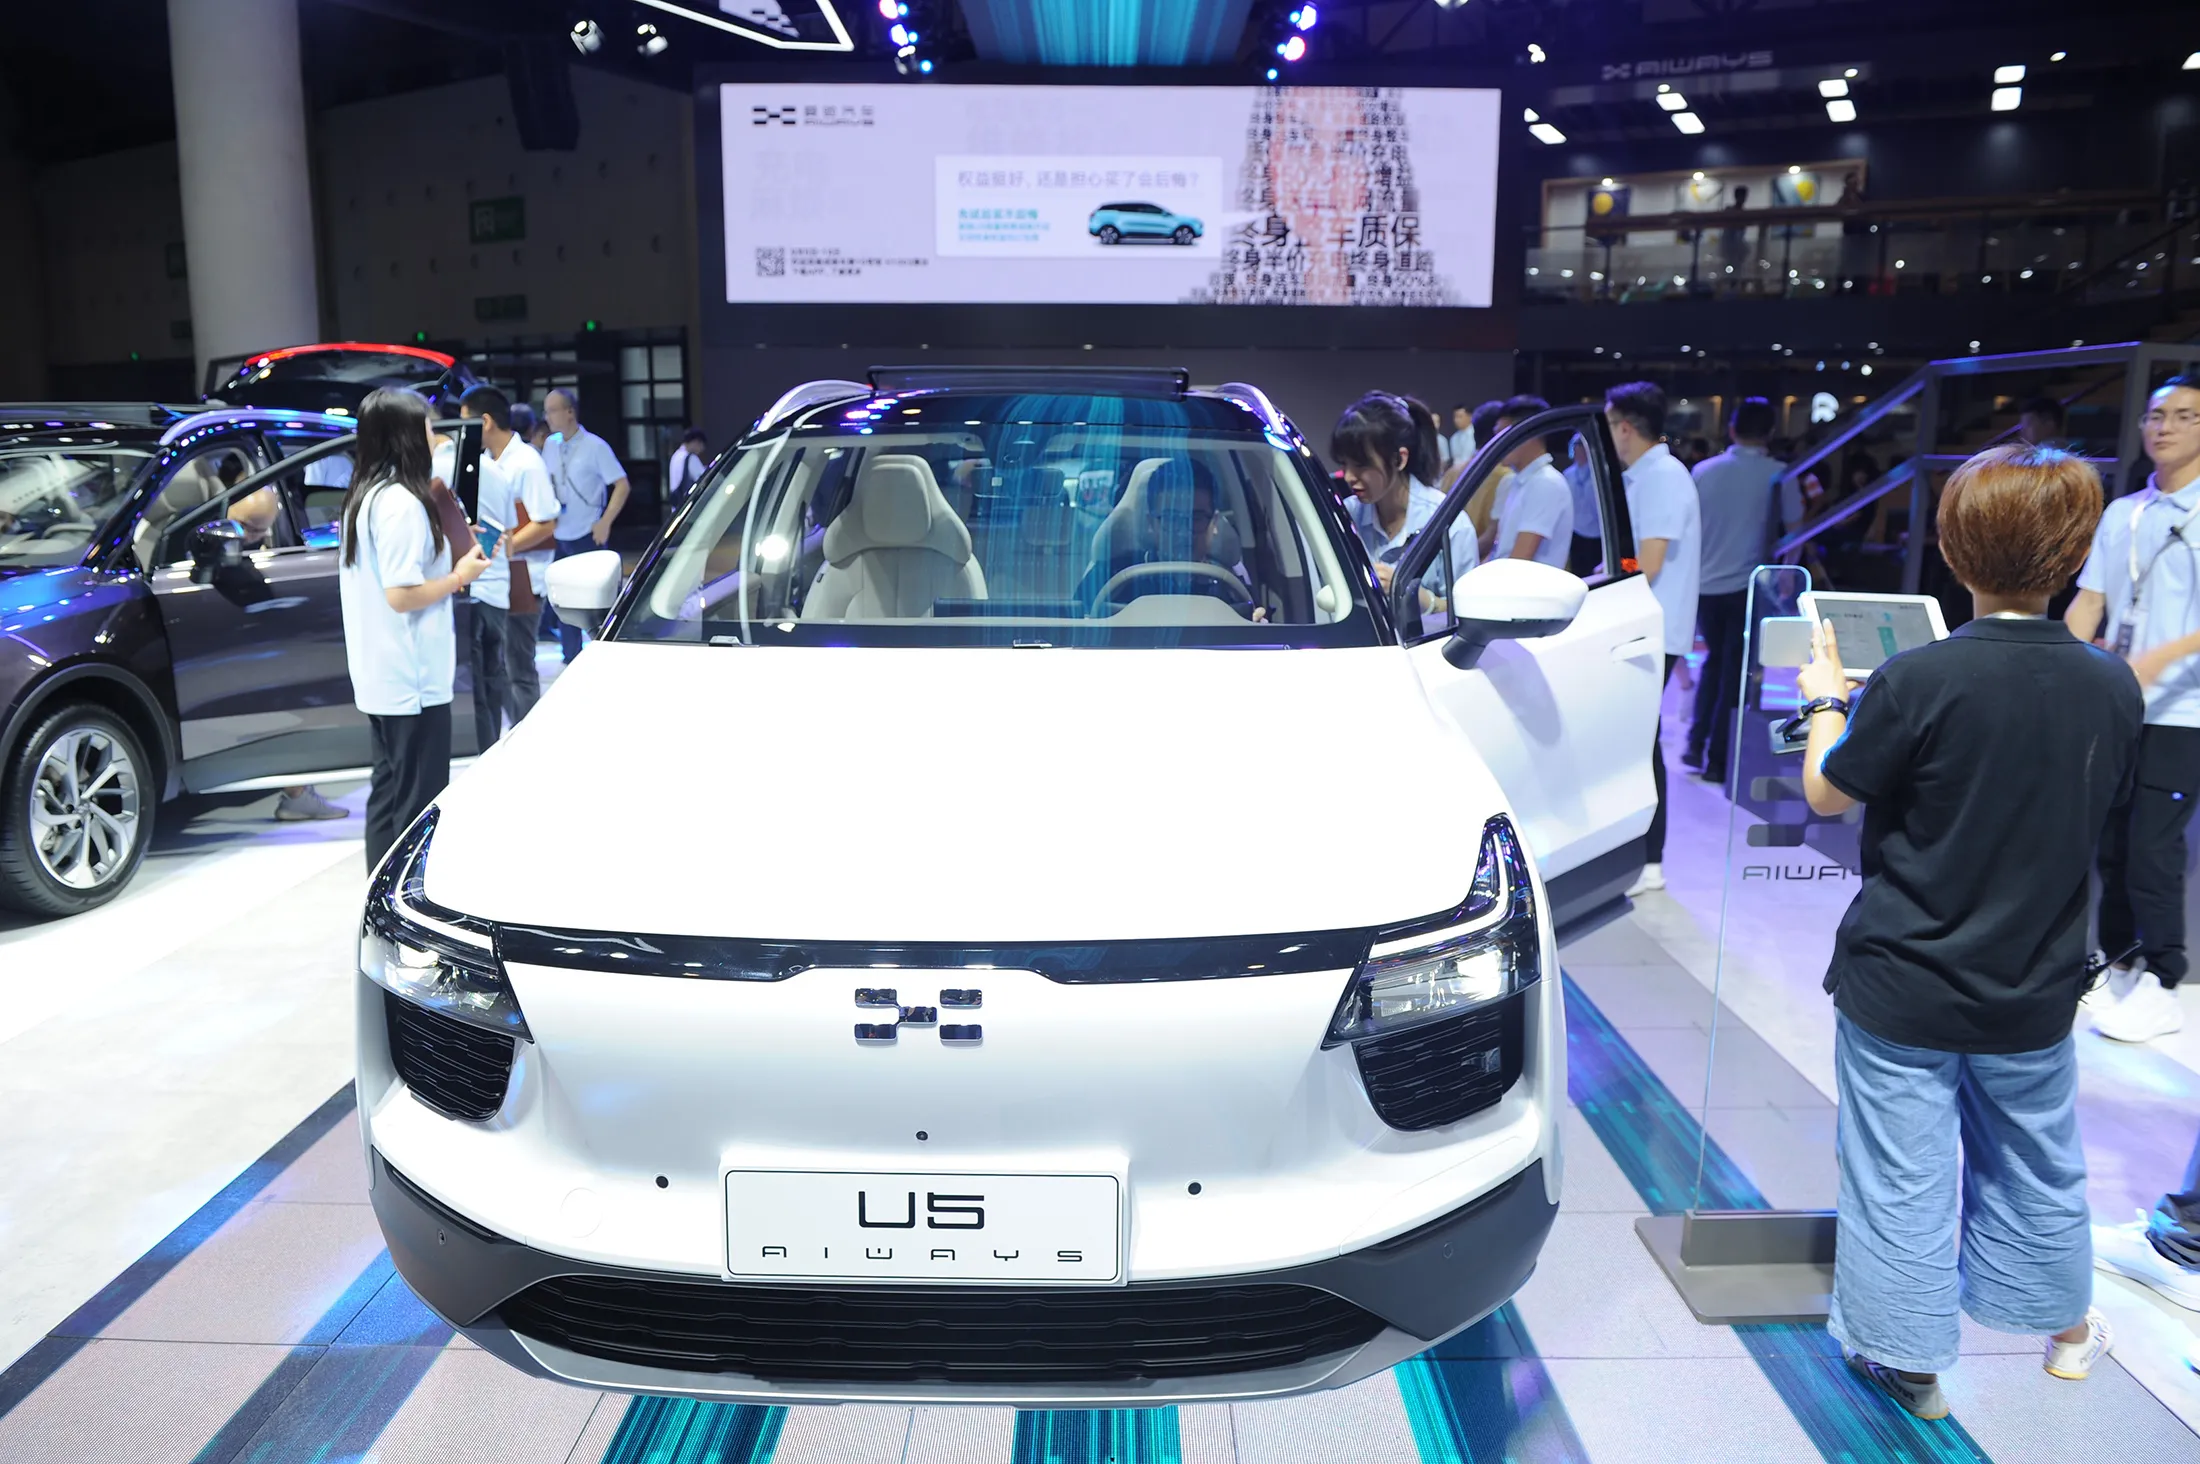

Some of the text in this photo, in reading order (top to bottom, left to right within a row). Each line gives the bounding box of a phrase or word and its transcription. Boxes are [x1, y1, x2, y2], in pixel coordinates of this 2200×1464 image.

[1743, 866, 1862, 880] AIWA
[858, 1191, 985, 1230] U5
[762, 1245, 1082, 1263] AIWAYS
